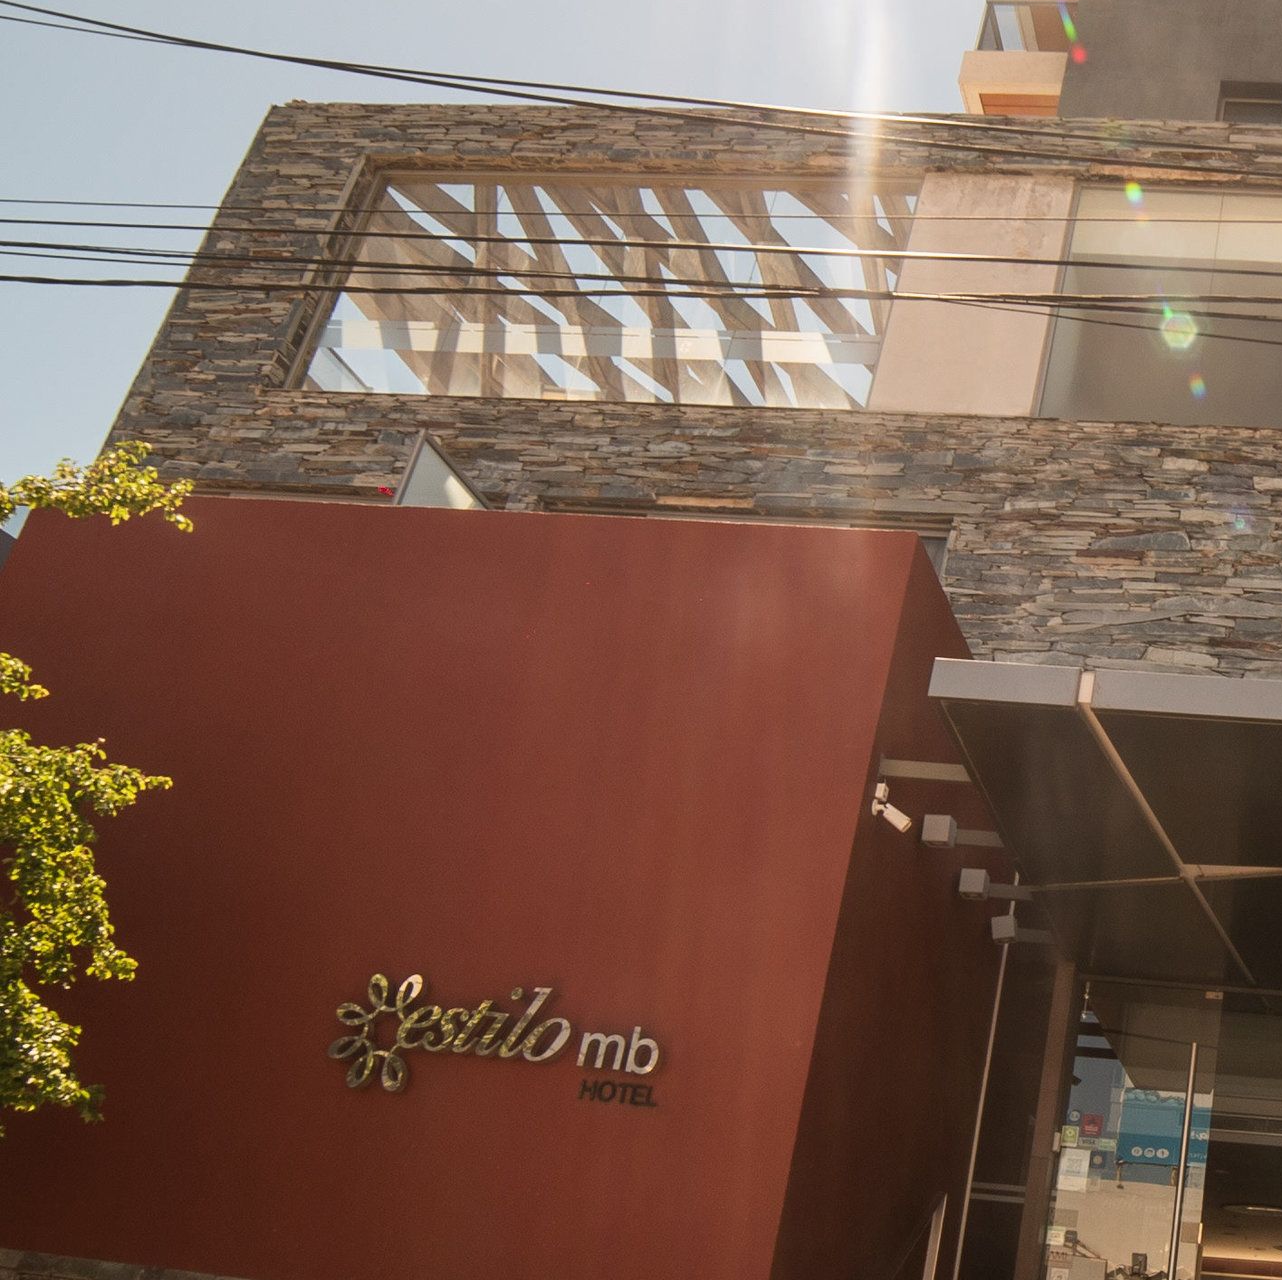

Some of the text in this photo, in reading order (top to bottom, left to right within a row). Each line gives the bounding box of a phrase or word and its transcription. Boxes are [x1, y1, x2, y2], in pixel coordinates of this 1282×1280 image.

[397, 986, 660, 1075] estilo mb
[578, 1079, 658, 1108] HOTEL
